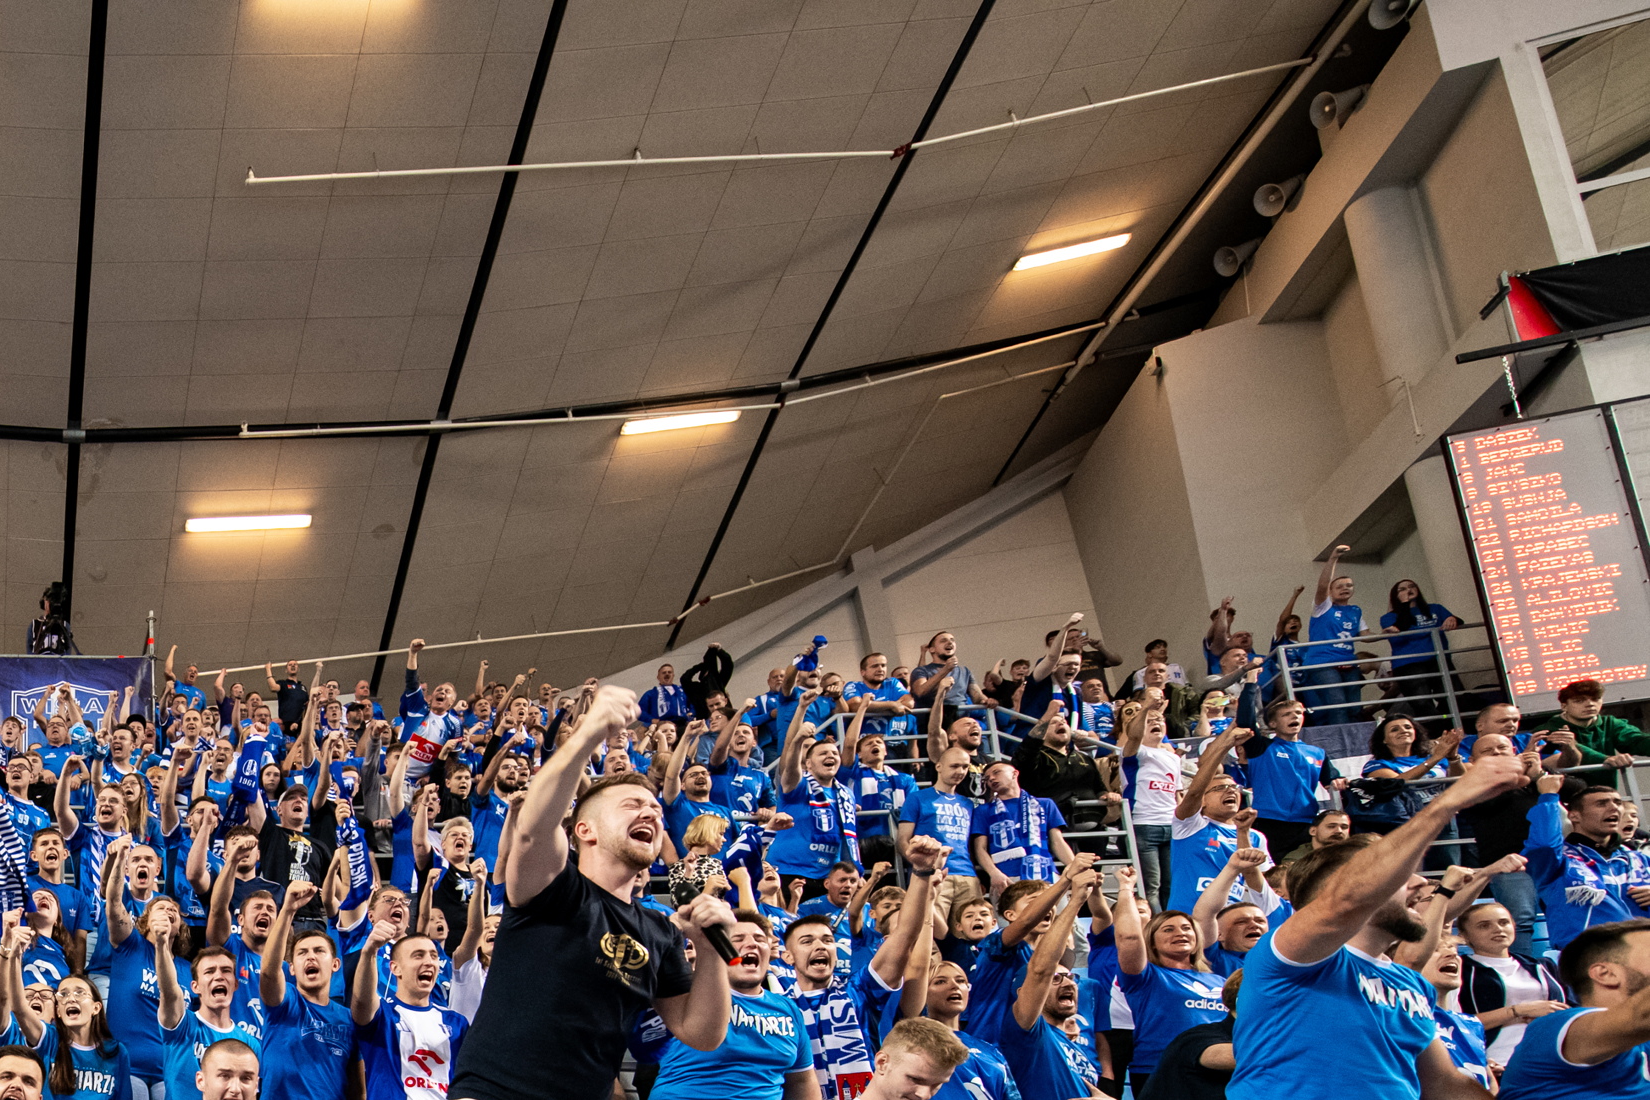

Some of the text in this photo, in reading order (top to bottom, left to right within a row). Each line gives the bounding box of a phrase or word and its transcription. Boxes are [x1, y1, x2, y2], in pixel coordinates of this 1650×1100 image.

[1454, 426, 1540, 453] 3 DASZEK
[1460, 438, 1564, 469] 1 BERGERUD
[1462, 461, 1525, 484] 8 JANC
[1466, 472, 1563, 500] 9 SZYSZKO
[1474, 501, 1583, 532] 21 SAMOILA
[1478, 512, 1620, 547] 22 RICHARDSON
[1481, 534, 1590, 563] 23 ZARABEC
[1486, 550, 1595, 579] 24 FAZEKAS
[1490, 563, 1623, 596] 26 KRAJEWSKI
[1493, 582, 1615, 612] 32 ALILOVIC
[1497, 613, 1521, 628] 33
[1502, 620, 1590, 645] 34 MIHIC
[1507, 638, 1584, 661] 45 ILIC
[1543, 653, 1601, 673] SZITA
[1515, 680, 1538, 695] 99
[414, 749, 434, 761] RLEN
[348, 842, 368, 889] POLSKI
[1201, 880, 1245, 900] OEN
[237, 1020, 264, 1041] ORL
[405, 1075, 448, 1095] ORLN
